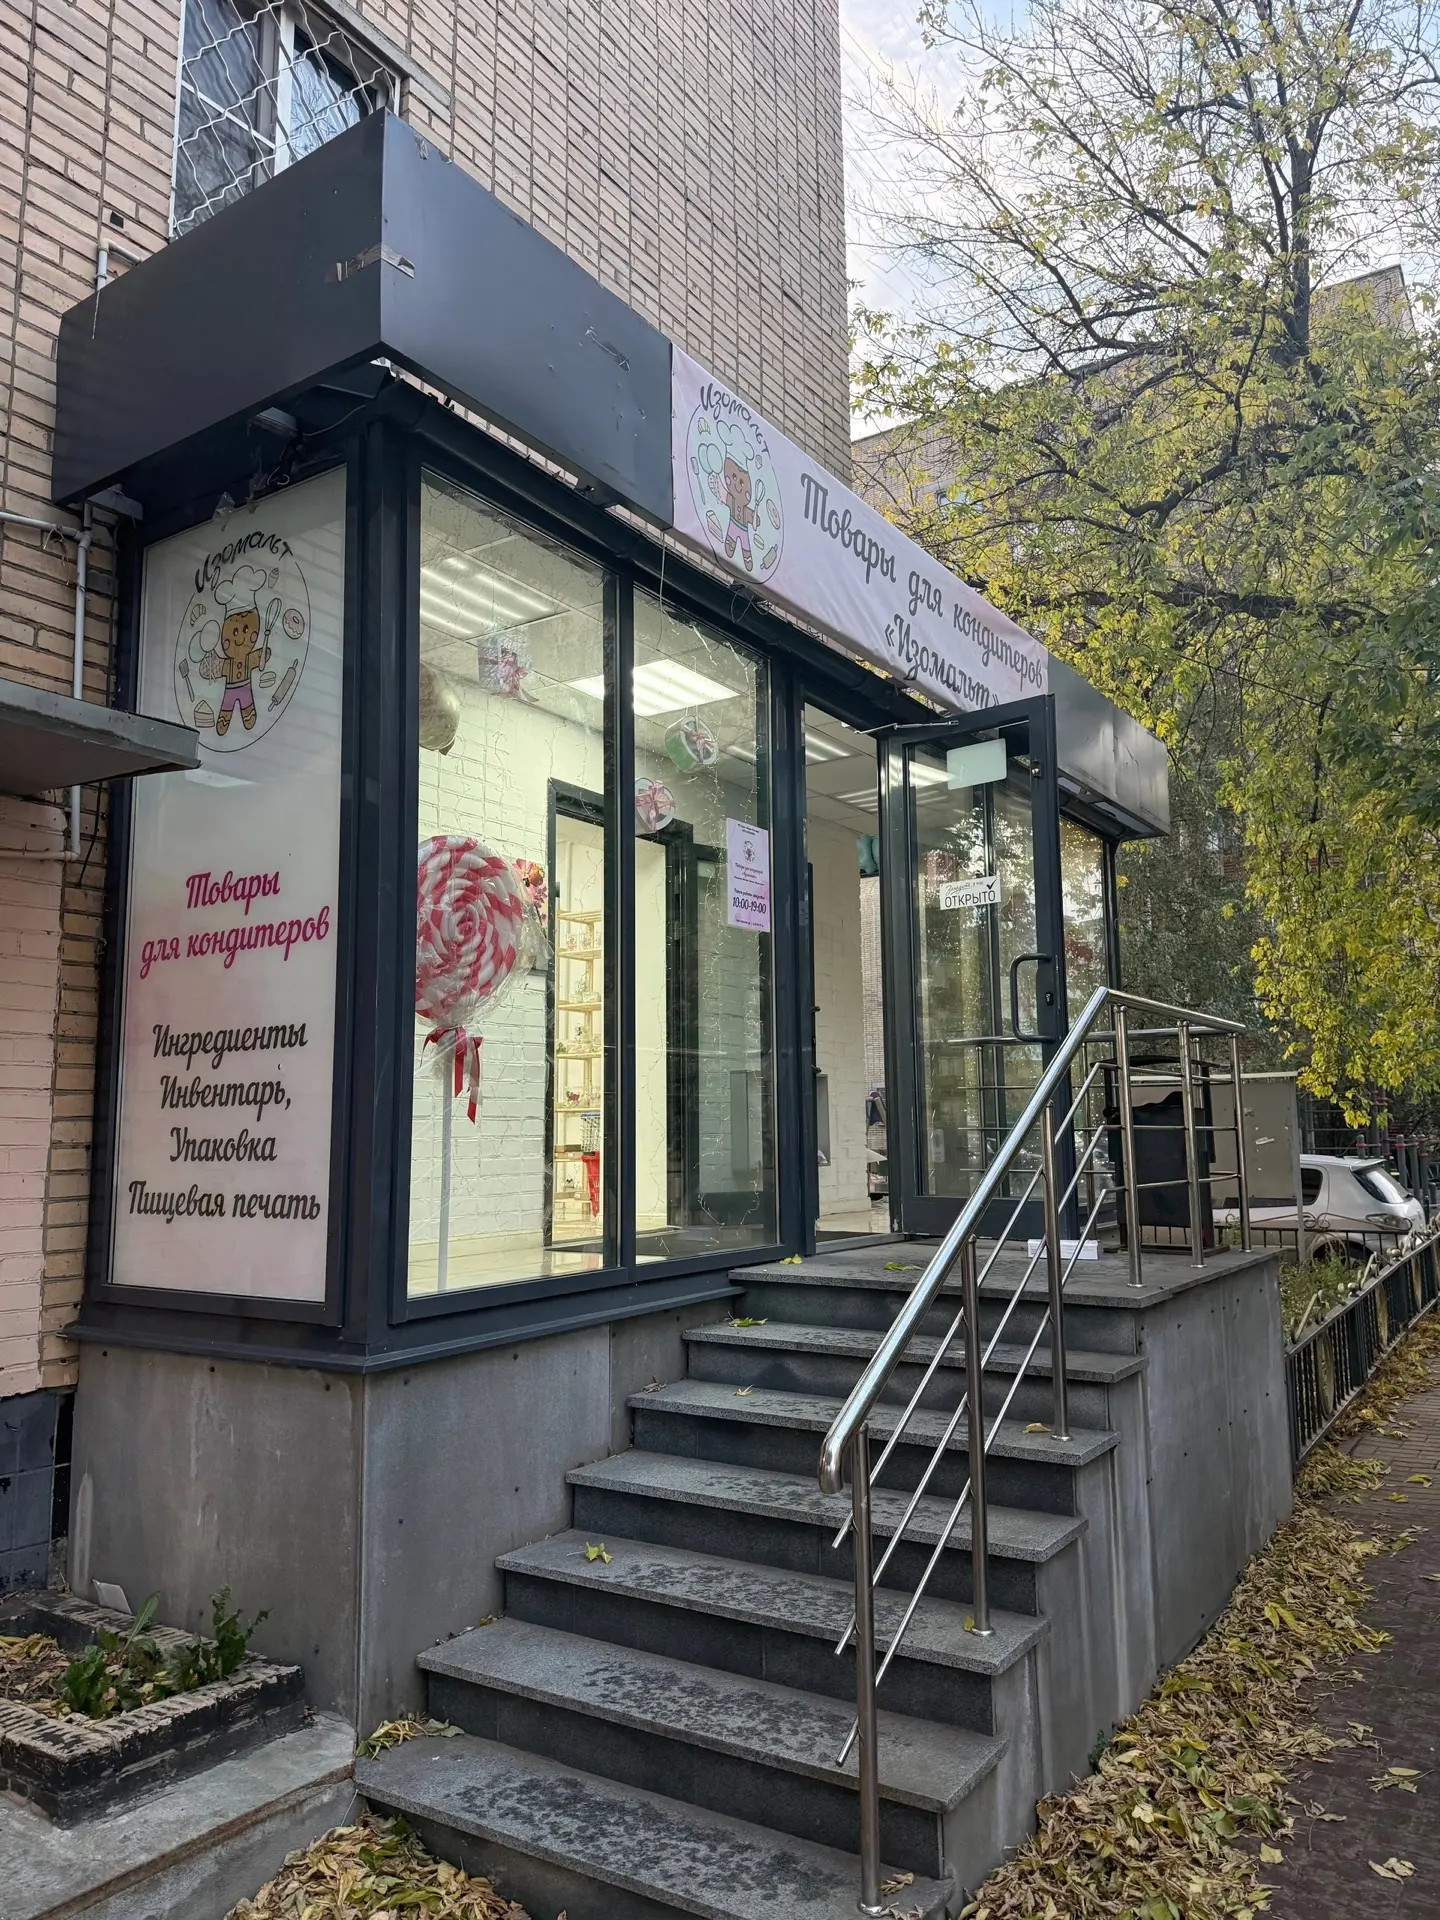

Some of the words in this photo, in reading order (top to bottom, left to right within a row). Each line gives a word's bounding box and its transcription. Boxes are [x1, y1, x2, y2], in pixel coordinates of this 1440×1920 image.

[195, 530, 294, 594] Изомальт
[801, 472, 897, 585] Товары
[908, 570, 944, 617] для
[953, 603, 1044, 692] кондитеров
[185, 870, 281, 916] Товары
[732, 896, 767, 915] 10:00-19:00
[944, 890, 996, 908] ОТКРЫТО
[139, 936, 181, 979] для
[186, 905, 330, 969] кондитеров
[152, 1022, 309, 1072] Ингредиенты
[160, 1075, 292, 1122] Инвентарь,
[169, 1126, 278, 1162] Упаковка
[128, 1180, 226, 1224] Пищевая
[231, 1193, 321, 1220] печать
